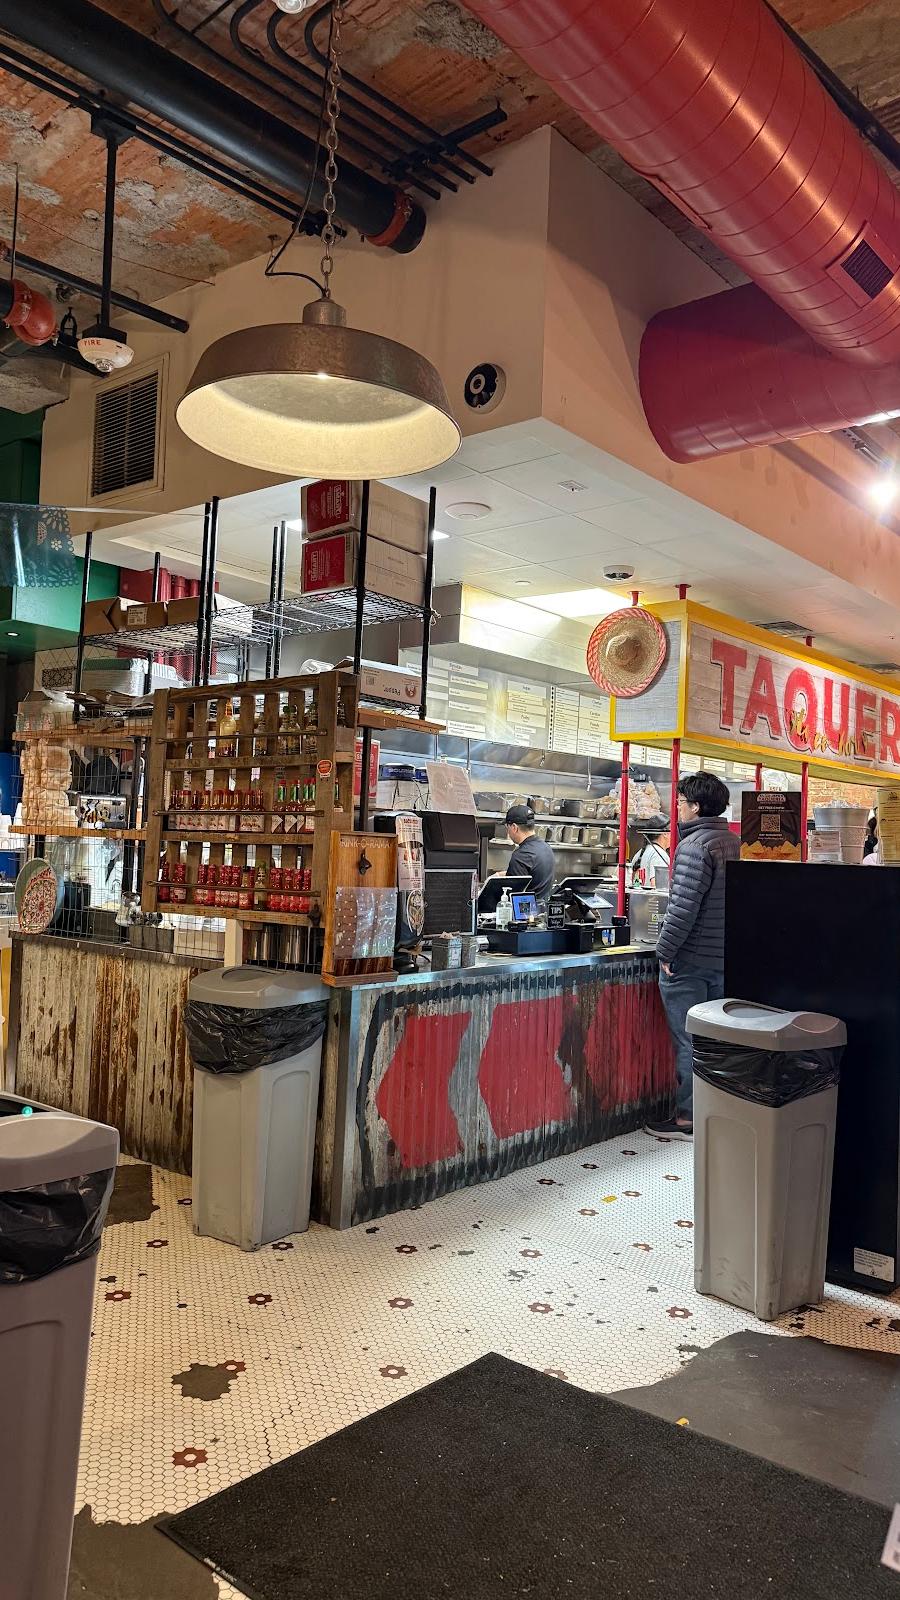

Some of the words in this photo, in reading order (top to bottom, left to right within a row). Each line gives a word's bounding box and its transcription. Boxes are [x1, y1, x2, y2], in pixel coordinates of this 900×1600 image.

[710, 637, 900, 766] TAQUER
[340, 838, 390, 848] RINK-O-RAMA
[550, 906, 563, 915] TIPS
